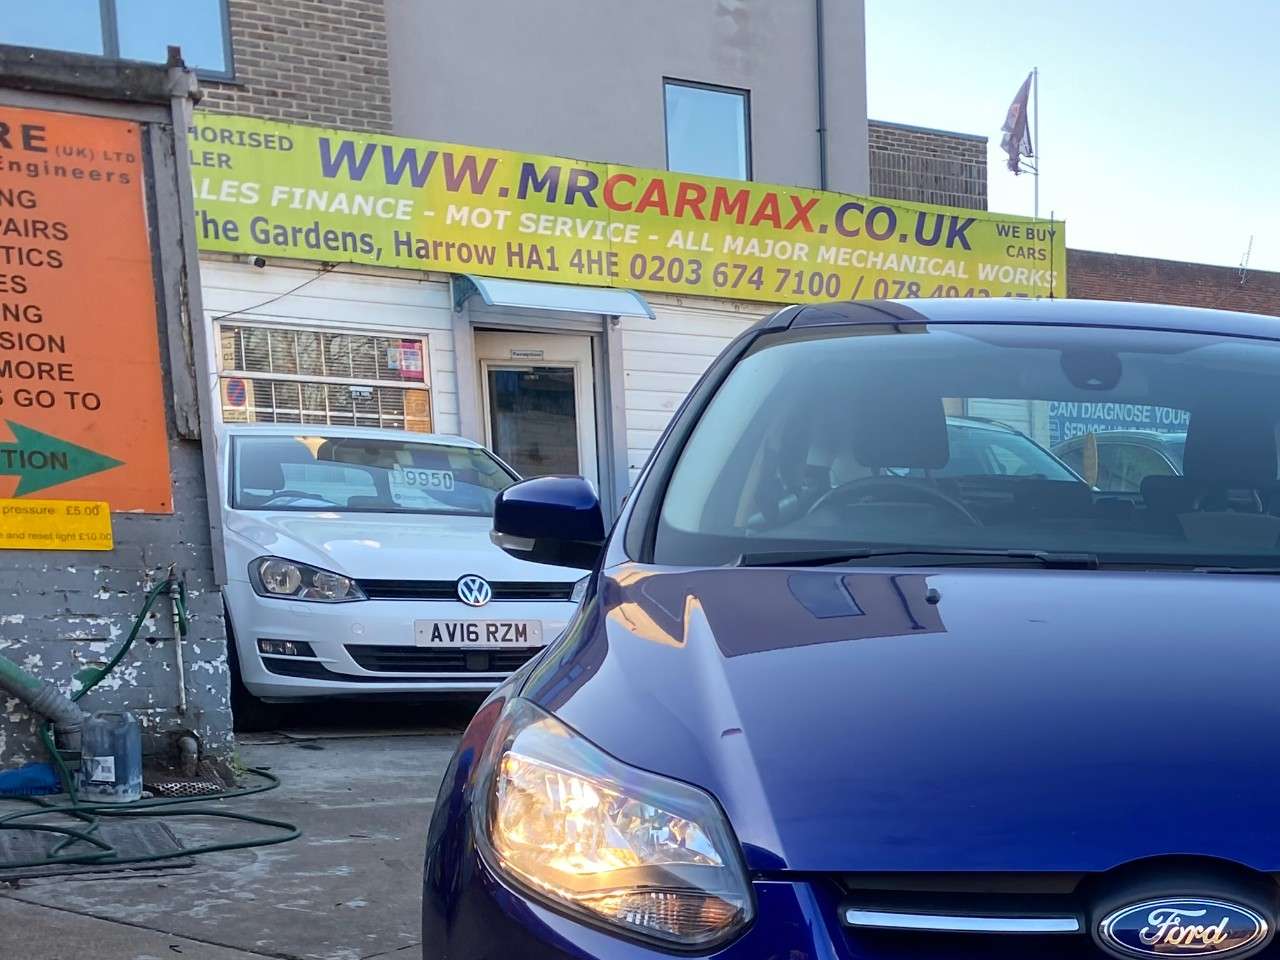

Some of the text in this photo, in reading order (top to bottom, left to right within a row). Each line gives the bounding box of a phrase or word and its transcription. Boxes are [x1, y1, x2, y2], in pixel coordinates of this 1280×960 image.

[56, 145, 95, 162] (UK)
[103, 150, 136, 164] LTD
[0, 155, 130, 185] ngineers
[318, 136, 977, 251] WWW.MRCARMAX.CO.UK
[0, 217, 69, 241] AIRS
[271, 185, 415, 220] FINANCE
[445, 204, 512, 231] MOT
[519, 213, 640, 244] SERVICE
[667, 229, 714, 252] ALL
[723, 235, 809, 263] MAJOR
[817, 246, 969, 279] MECHANICAL
[978, 263, 1058, 288] WORKS
[996, 223, 1056, 242] WE BUY
[0, 245, 63, 269] TICS
[193, 209, 240, 242] he
[250, 216, 383, 261] Gardens,
[393, 230, 496, 266] Harrow
[506, 241, 559, 272] HA1
[569, 249, 620, 277] 4HE
[630, 253, 702, 286] 0203
[713, 262, 764, 291] 674
[774, 268, 841, 298] 7100
[873, 278, 921, 300] 078
[1006, 244, 1047, 261] CARS
[2, 303, 43, 323] NG
[0, 331, 65, 353] SION
[13, 388, 55, 409] GO
[64, 391, 101, 411] TO
[1049, 401, 1078, 418] CAN
[1081, 402, 1152, 423] DIAGNOSE
[4, 449, 68, 471] TION
[430, 623, 528, 643] AV16 RZM
[1139, 908, 1229, 947] Ford
